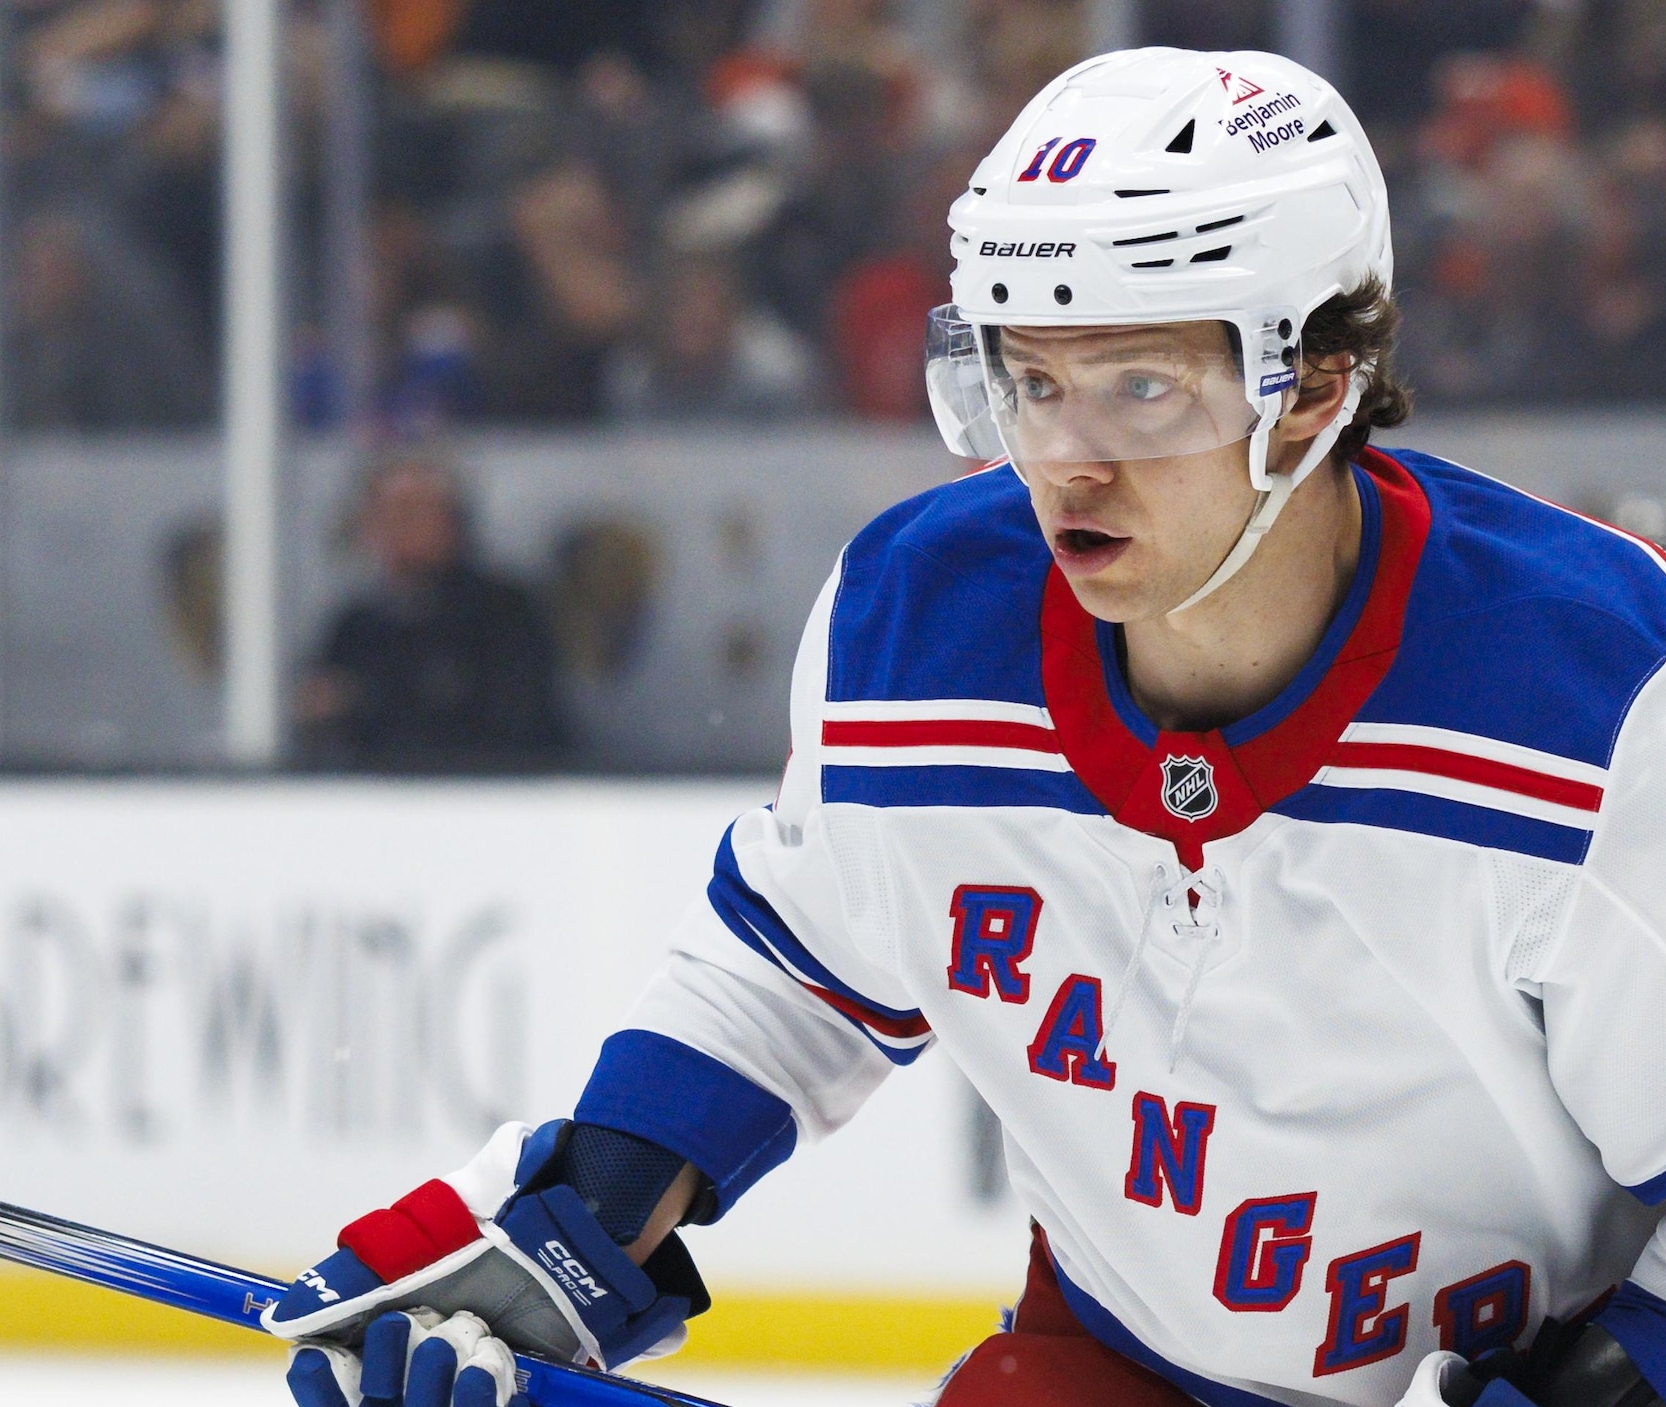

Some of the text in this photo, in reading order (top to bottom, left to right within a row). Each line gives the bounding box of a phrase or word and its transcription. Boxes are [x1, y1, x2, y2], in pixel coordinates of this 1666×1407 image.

[1247, 119, 1305, 154] Moore
[1017, 136, 1097, 184] 10
[1174, 772, 1205, 806] NHL
[947, 884, 1617, 1376] RANGER
[545, 1240, 608, 1298] CCM
[551, 1266, 578, 1290] PRO
